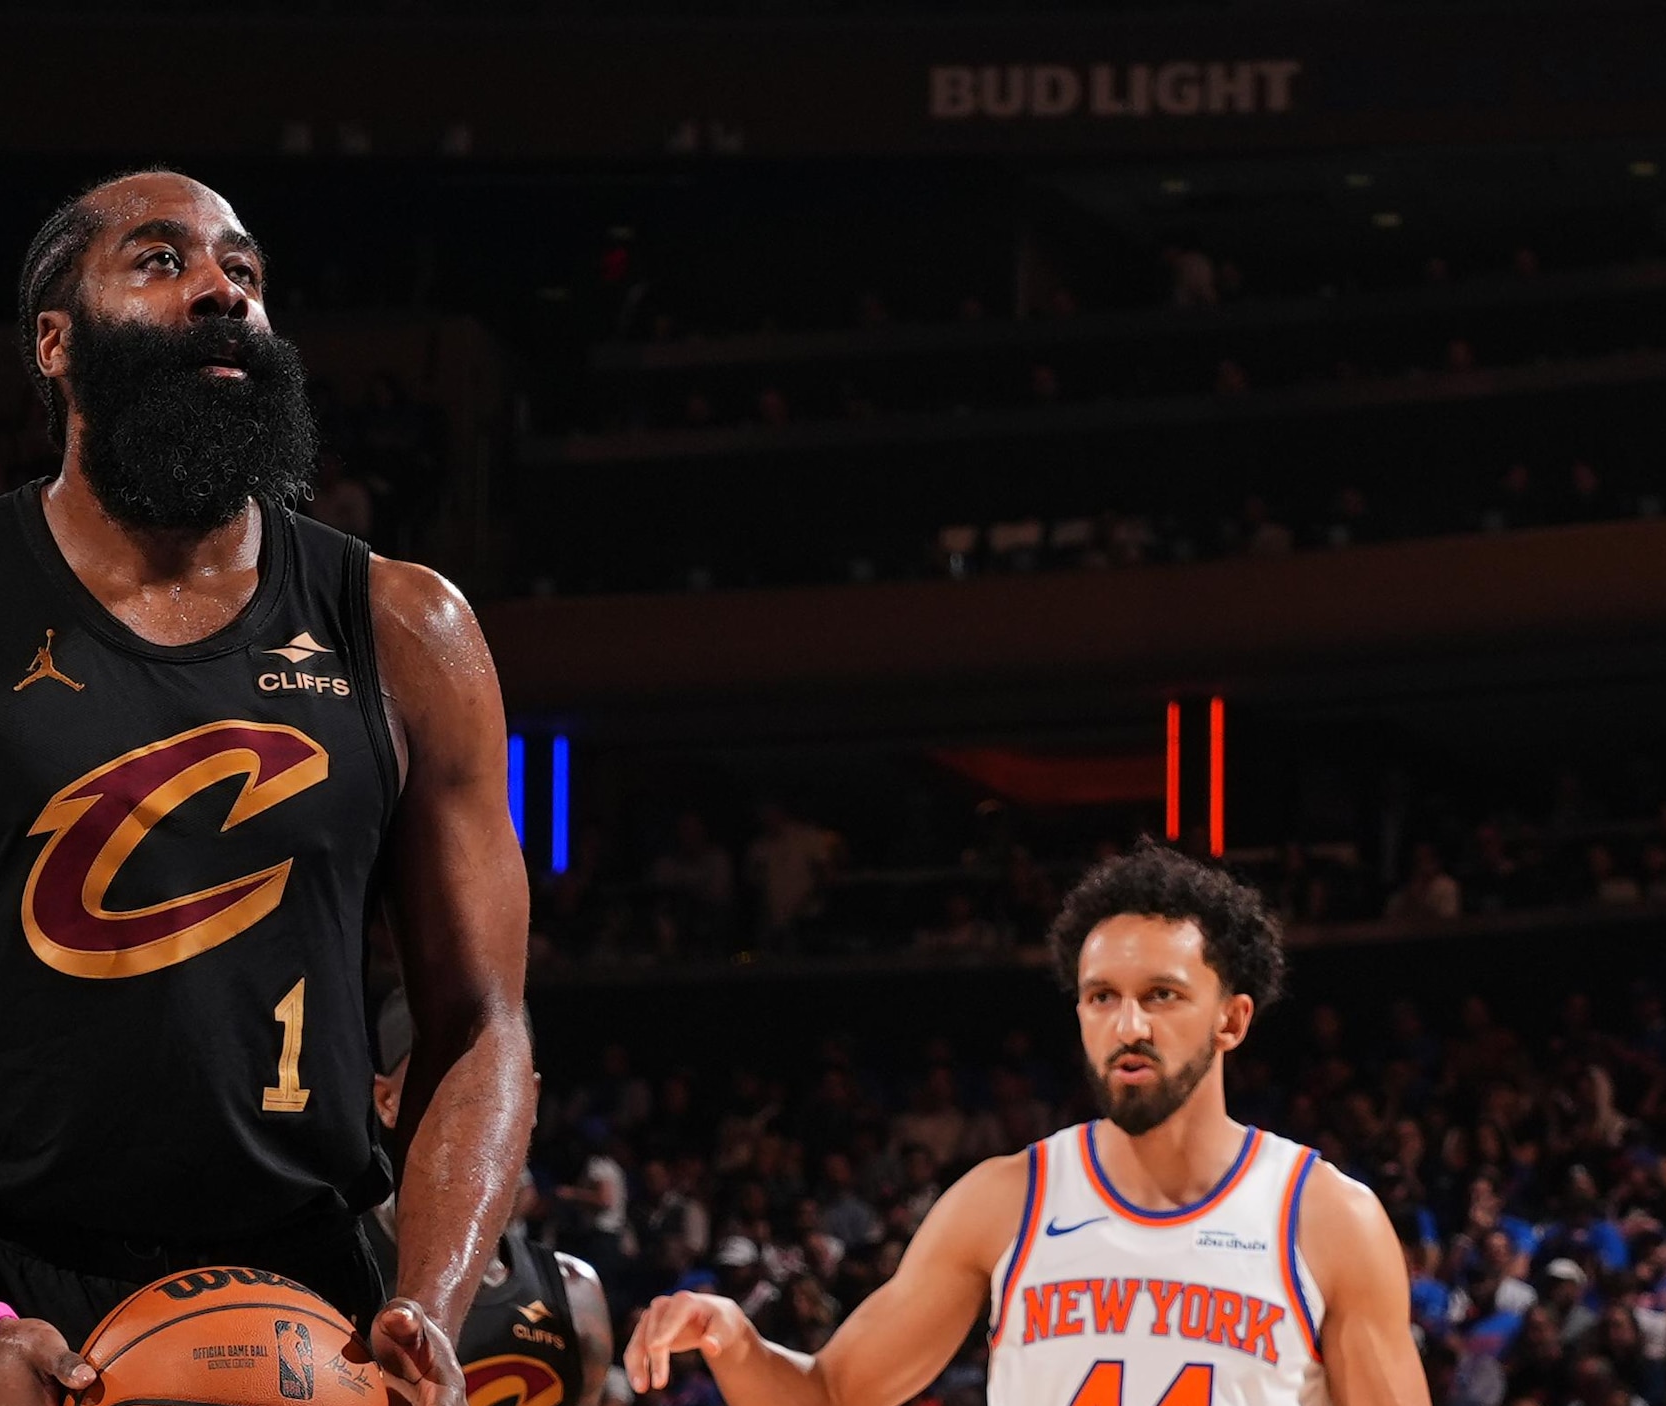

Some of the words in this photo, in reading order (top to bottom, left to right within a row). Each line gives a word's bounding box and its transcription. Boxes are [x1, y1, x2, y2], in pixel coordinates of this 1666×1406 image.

[929, 64, 1082, 119] BUD
[1088, 60, 1302, 116] LIGHT
[257, 671, 352, 697] CLIFFS
[261, 976, 311, 1113] 1
[511, 1322, 567, 1352] CLIFFS
[1023, 1278, 1143, 1346] NEW
[1142, 1279, 1286, 1366] YORK
[193, 1346, 226, 1361] OFFICIAL
[228, 1344, 249, 1358] GAME
[250, 1344, 269, 1358] BALL
